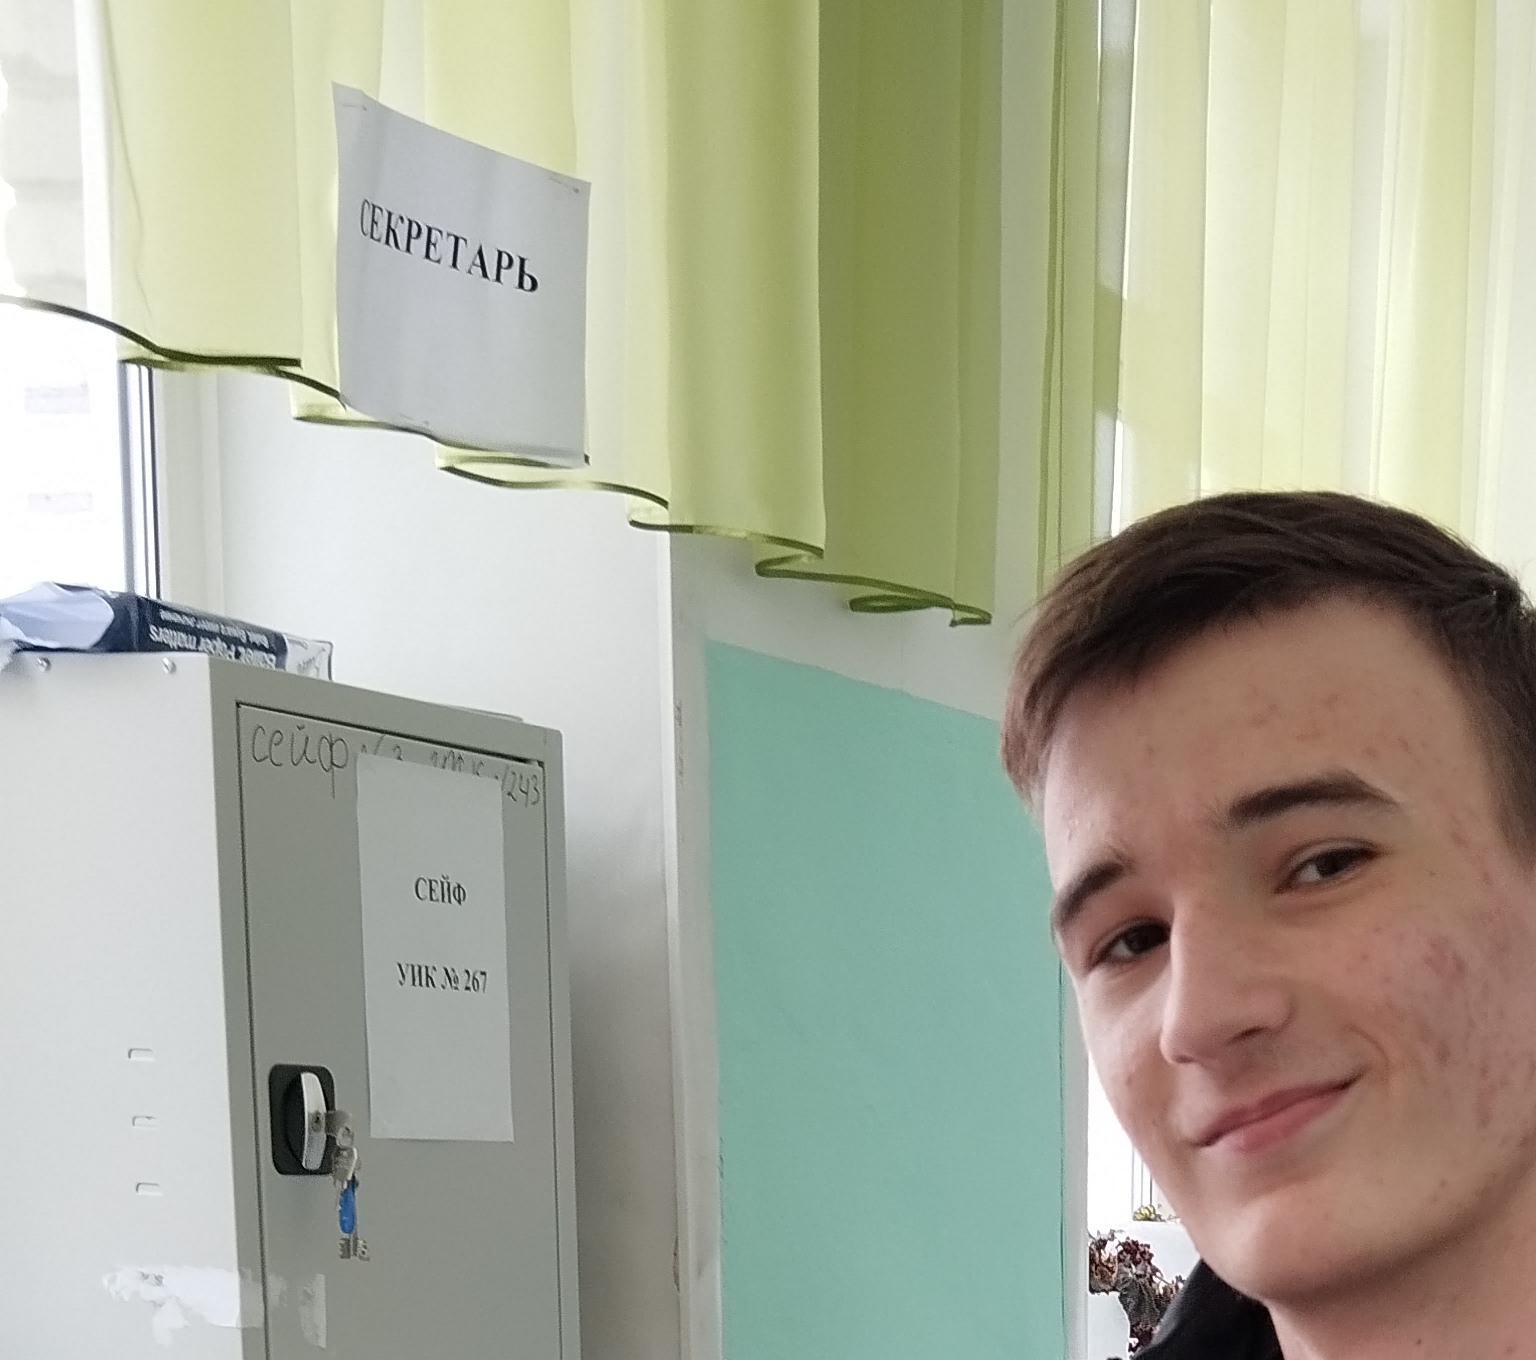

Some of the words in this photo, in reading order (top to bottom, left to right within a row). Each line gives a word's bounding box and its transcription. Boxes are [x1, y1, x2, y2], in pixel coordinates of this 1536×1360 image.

[360, 198, 539, 292] СЕКРЕТАРЬ
[150, 624, 197, 650] matters
[251, 725, 349, 799] сейф
[414, 874, 467, 906] СЕЙФ
[396, 961, 437, 989] УИК
[440, 966, 460, 991] №
[464, 968, 488, 994] 267
